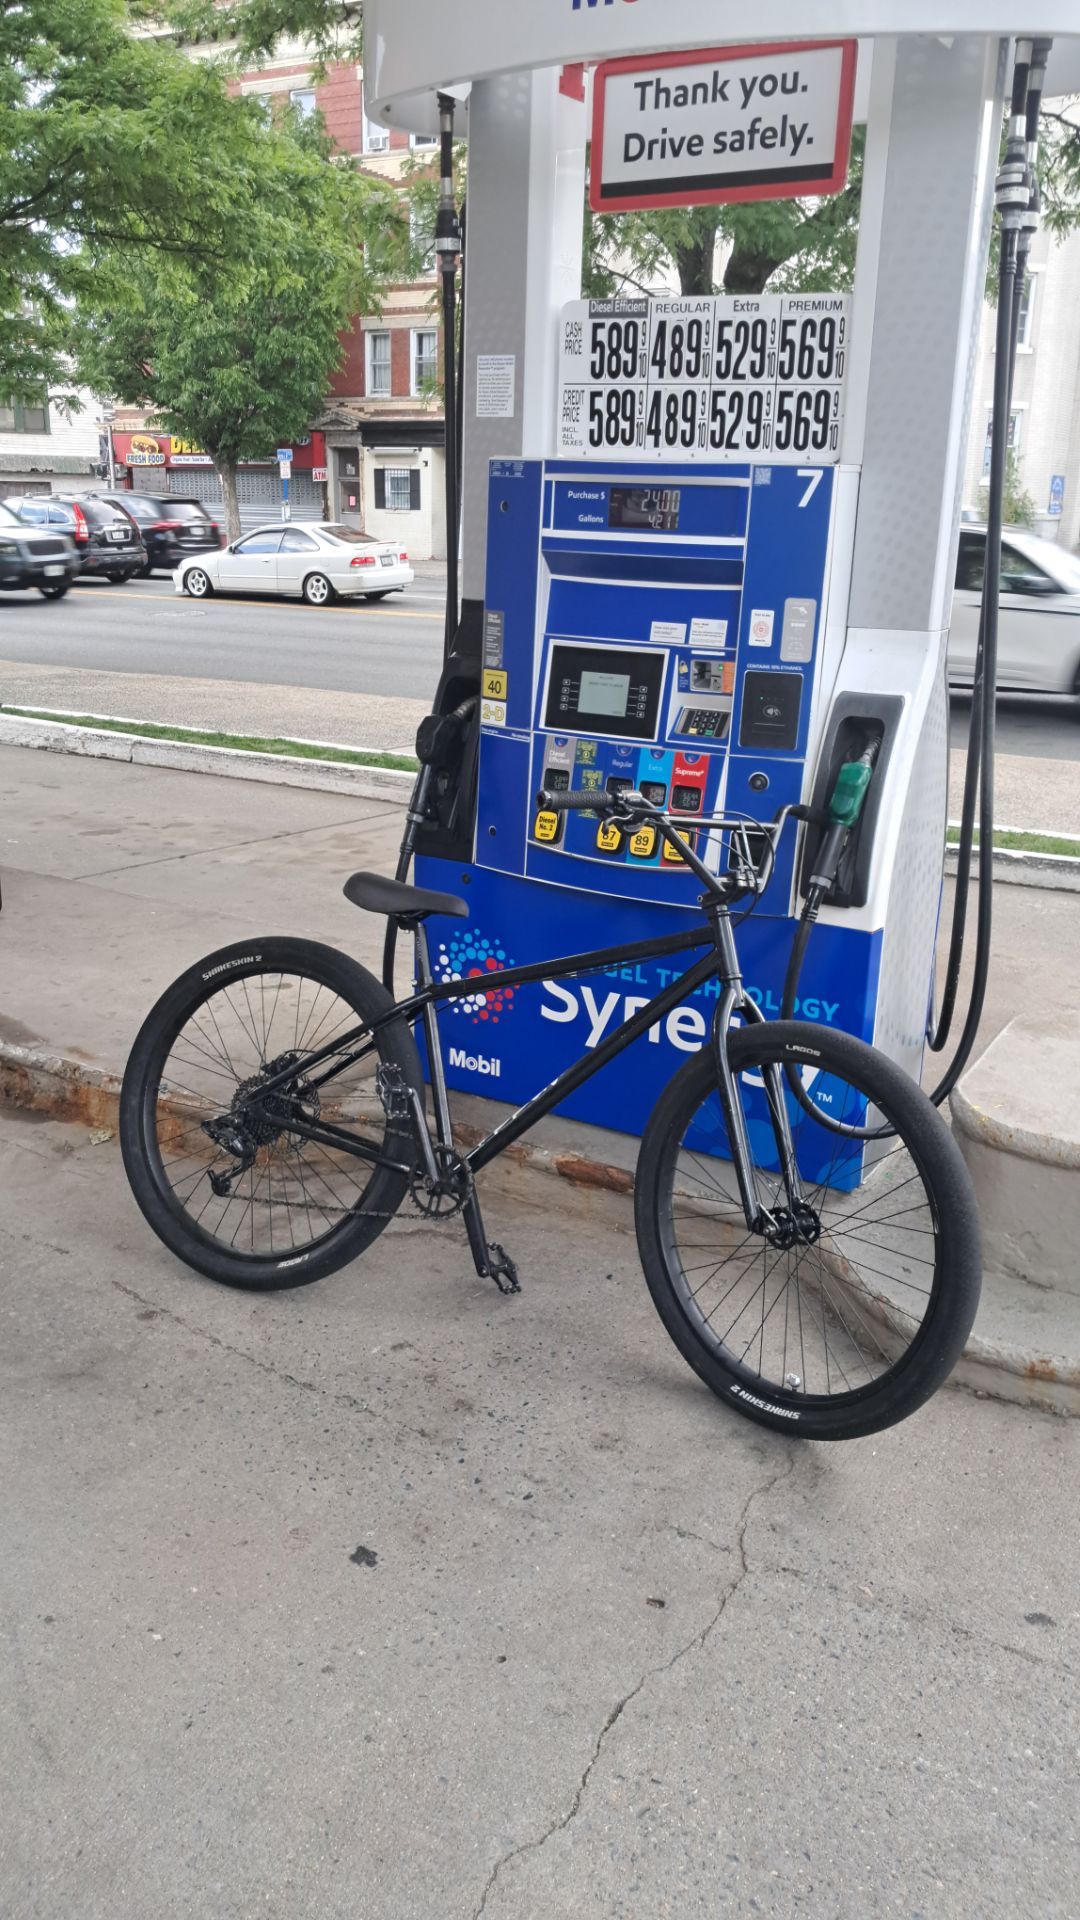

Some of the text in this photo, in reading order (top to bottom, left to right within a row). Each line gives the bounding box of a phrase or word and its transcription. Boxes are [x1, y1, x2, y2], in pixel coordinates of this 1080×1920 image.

[633, 70, 808, 111] Thank you.
[623, 114, 814, 163] Drive safely.
[590, 300, 647, 312] Diesel Efficient
[656, 302, 711, 313] REGULAR
[733, 300, 760, 312] Extra
[788, 300, 843, 312] PREMIUM
[565, 321, 583, 338] CASH
[564, 339, 583, 355] PRICE
[590, 320, 639, 379] 589
[651, 318, 702, 379] 489
[715, 318, 767, 380] 529
[778, 317, 836, 380] 569
[563, 389, 585, 406] CREDIT
[562, 407, 580, 422] PRICE
[589, 389, 636, 448] 589
[646, 389, 697, 448] 489
[710, 390, 763, 450] 529
[775, 389, 831, 451] 569
[127, 454, 164, 464] FRESH FOOD
[313, 471, 327, 481] ATM
[567, 490, 605, 500] Purchase $
[796, 469, 823, 508] 7
[578, 514, 603, 524] Gallons
[488, 680, 502, 694] 40
[611, 759, 633, 769] Regular
[538, 823, 548, 831] No.
[539, 815, 556, 824] Diesel
[635, 835, 650, 846] 89
[255, 954, 262, 962] 2
[541, 980, 820, 1092] Syne
[449, 1047, 501, 1078] Mobil
[730, 1384, 801, 1420] SNAKESKIN 2
